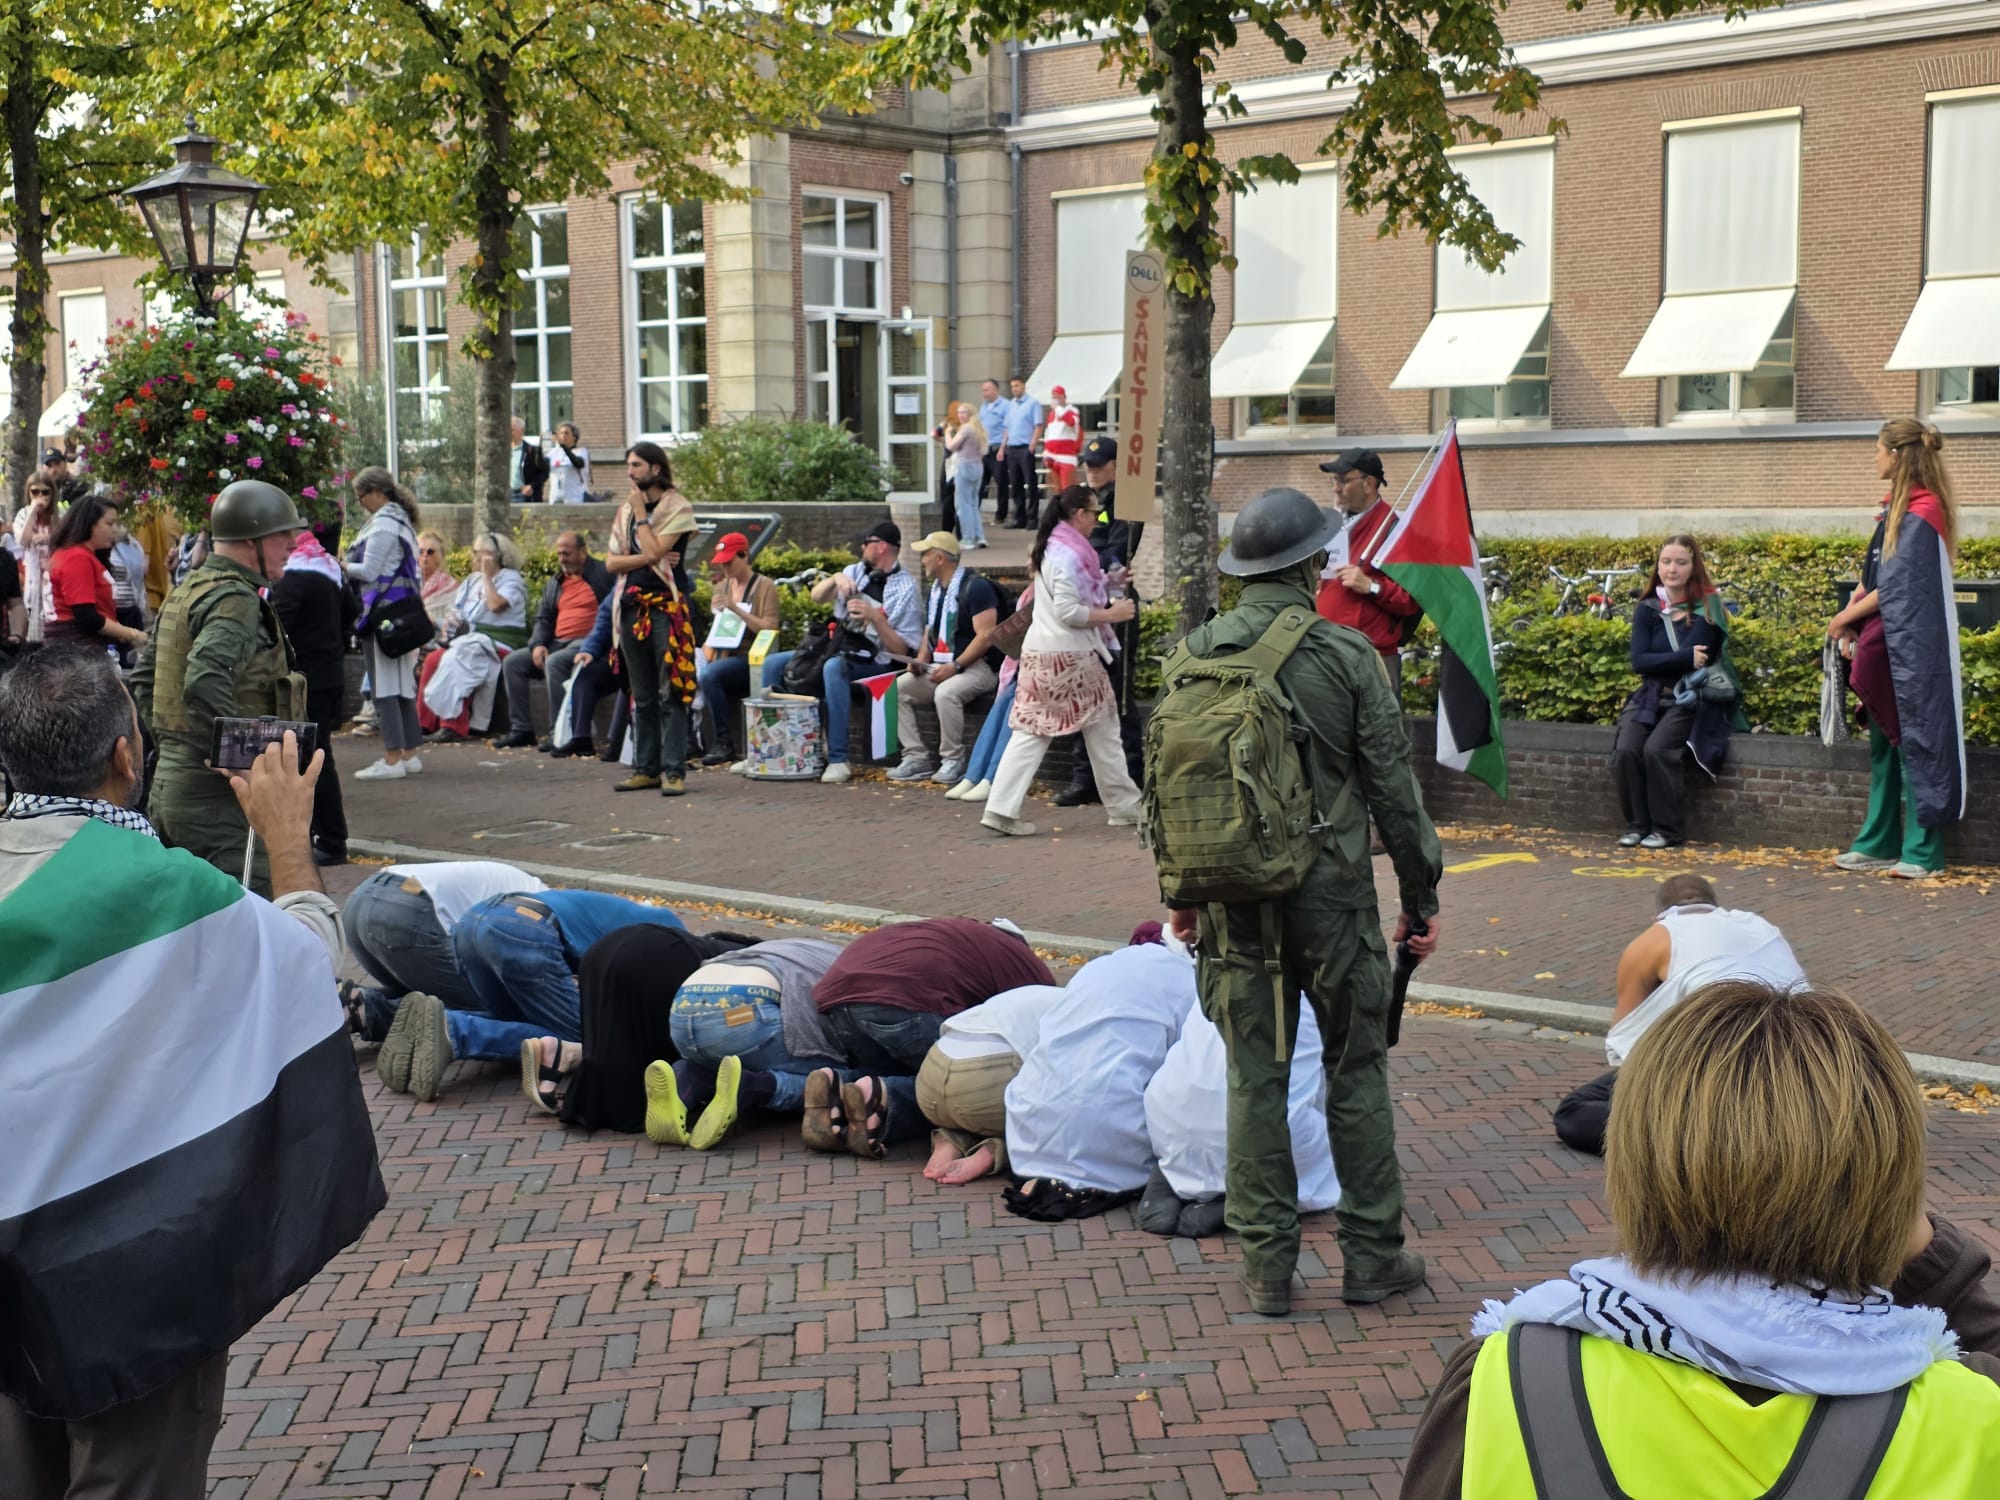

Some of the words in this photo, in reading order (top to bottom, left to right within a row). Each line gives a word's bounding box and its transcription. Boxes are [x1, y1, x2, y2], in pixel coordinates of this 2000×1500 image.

[1130, 265, 1159, 282] DELL
[1127, 296, 1150, 477] SANCTION
[684, 985, 733, 993] GAUBERT
